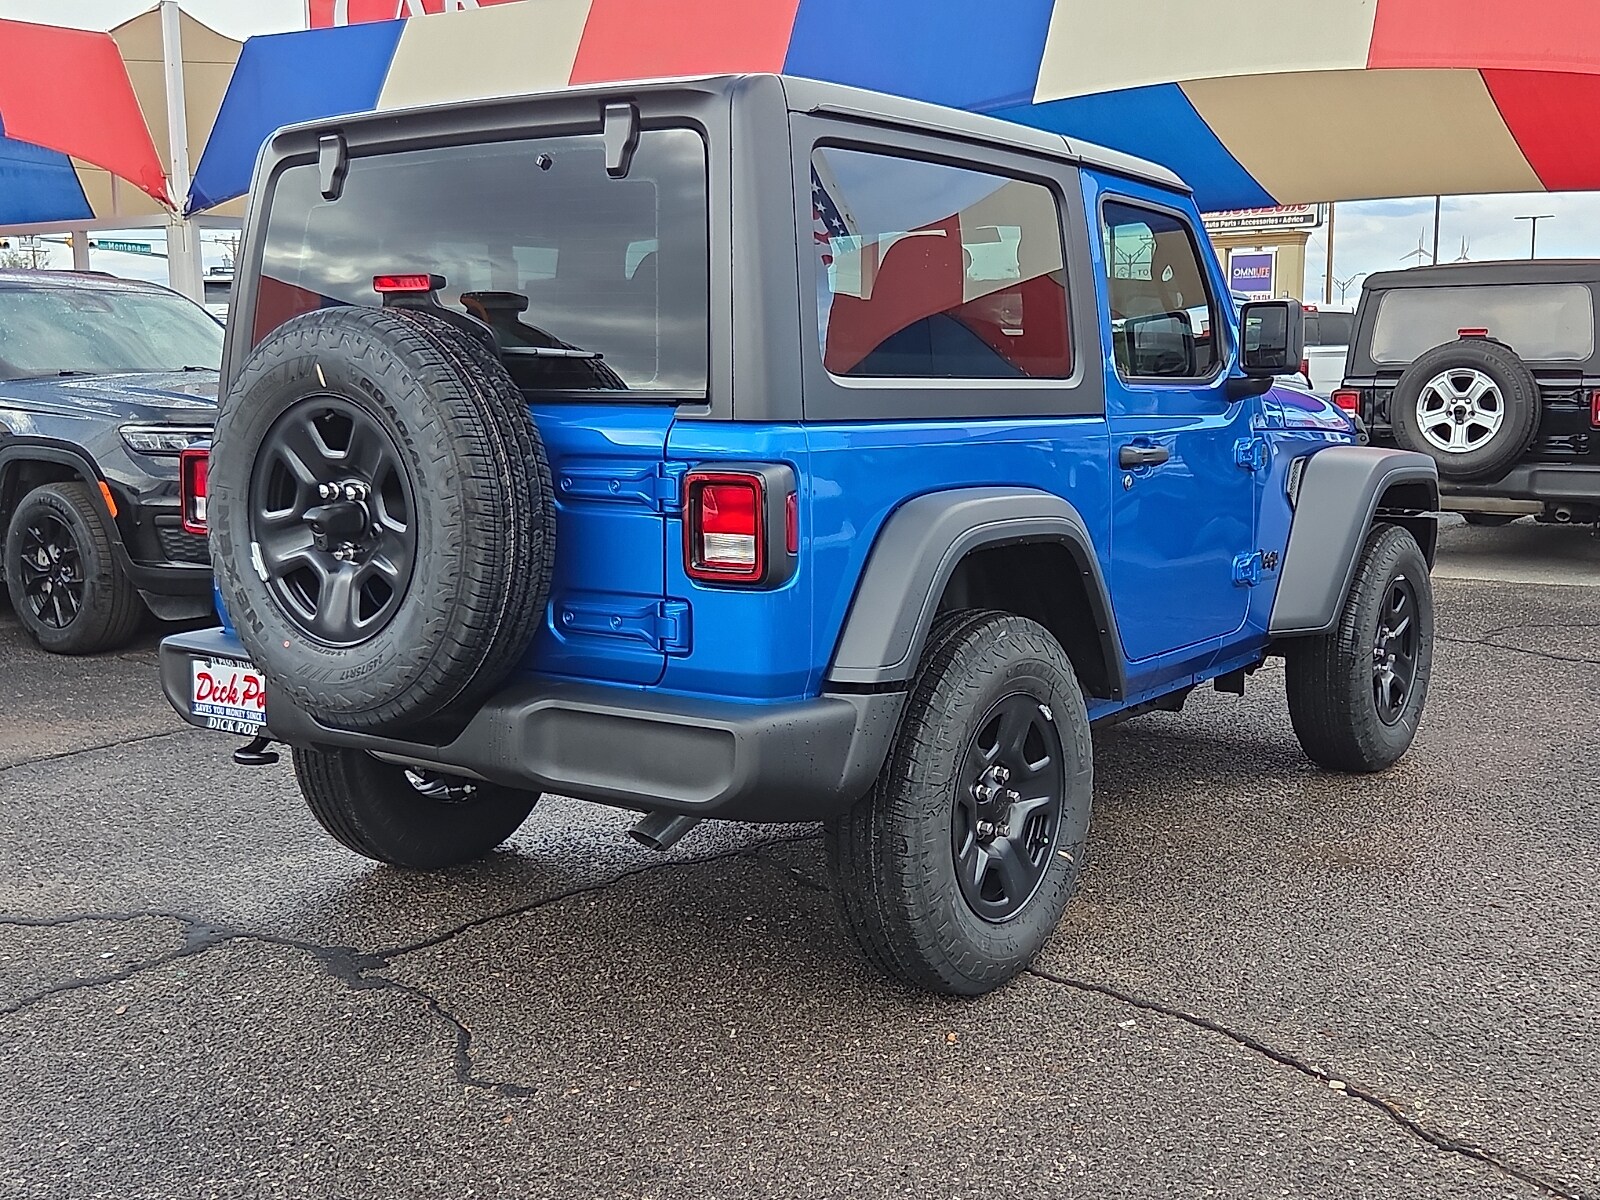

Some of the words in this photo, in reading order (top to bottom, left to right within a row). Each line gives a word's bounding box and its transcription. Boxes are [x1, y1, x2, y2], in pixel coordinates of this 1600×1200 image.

[1205, 221, 1220, 229] Auto
[1220, 220, 1237, 228] Parts
[1240, 217, 1279, 226] Accessories
[108, 242, 140, 252] Montana
[1233, 267, 1270, 277] OMNILIFE
[359, 377, 428, 488] ROADIAN
[217, 505, 265, 634] NEXEN
[340, 654, 383, 680] 245/75R17
[197, 673, 239, 705] Dick
[242, 675, 266, 709] Po
[195, 703, 212, 714] SAVES
[213, 706, 225, 715] YOU
[226, 708, 246, 719] MONEY
[246, 711, 262, 721] SINCE
[208, 717, 236, 732] DICK
[235, 721, 260, 736] POE
